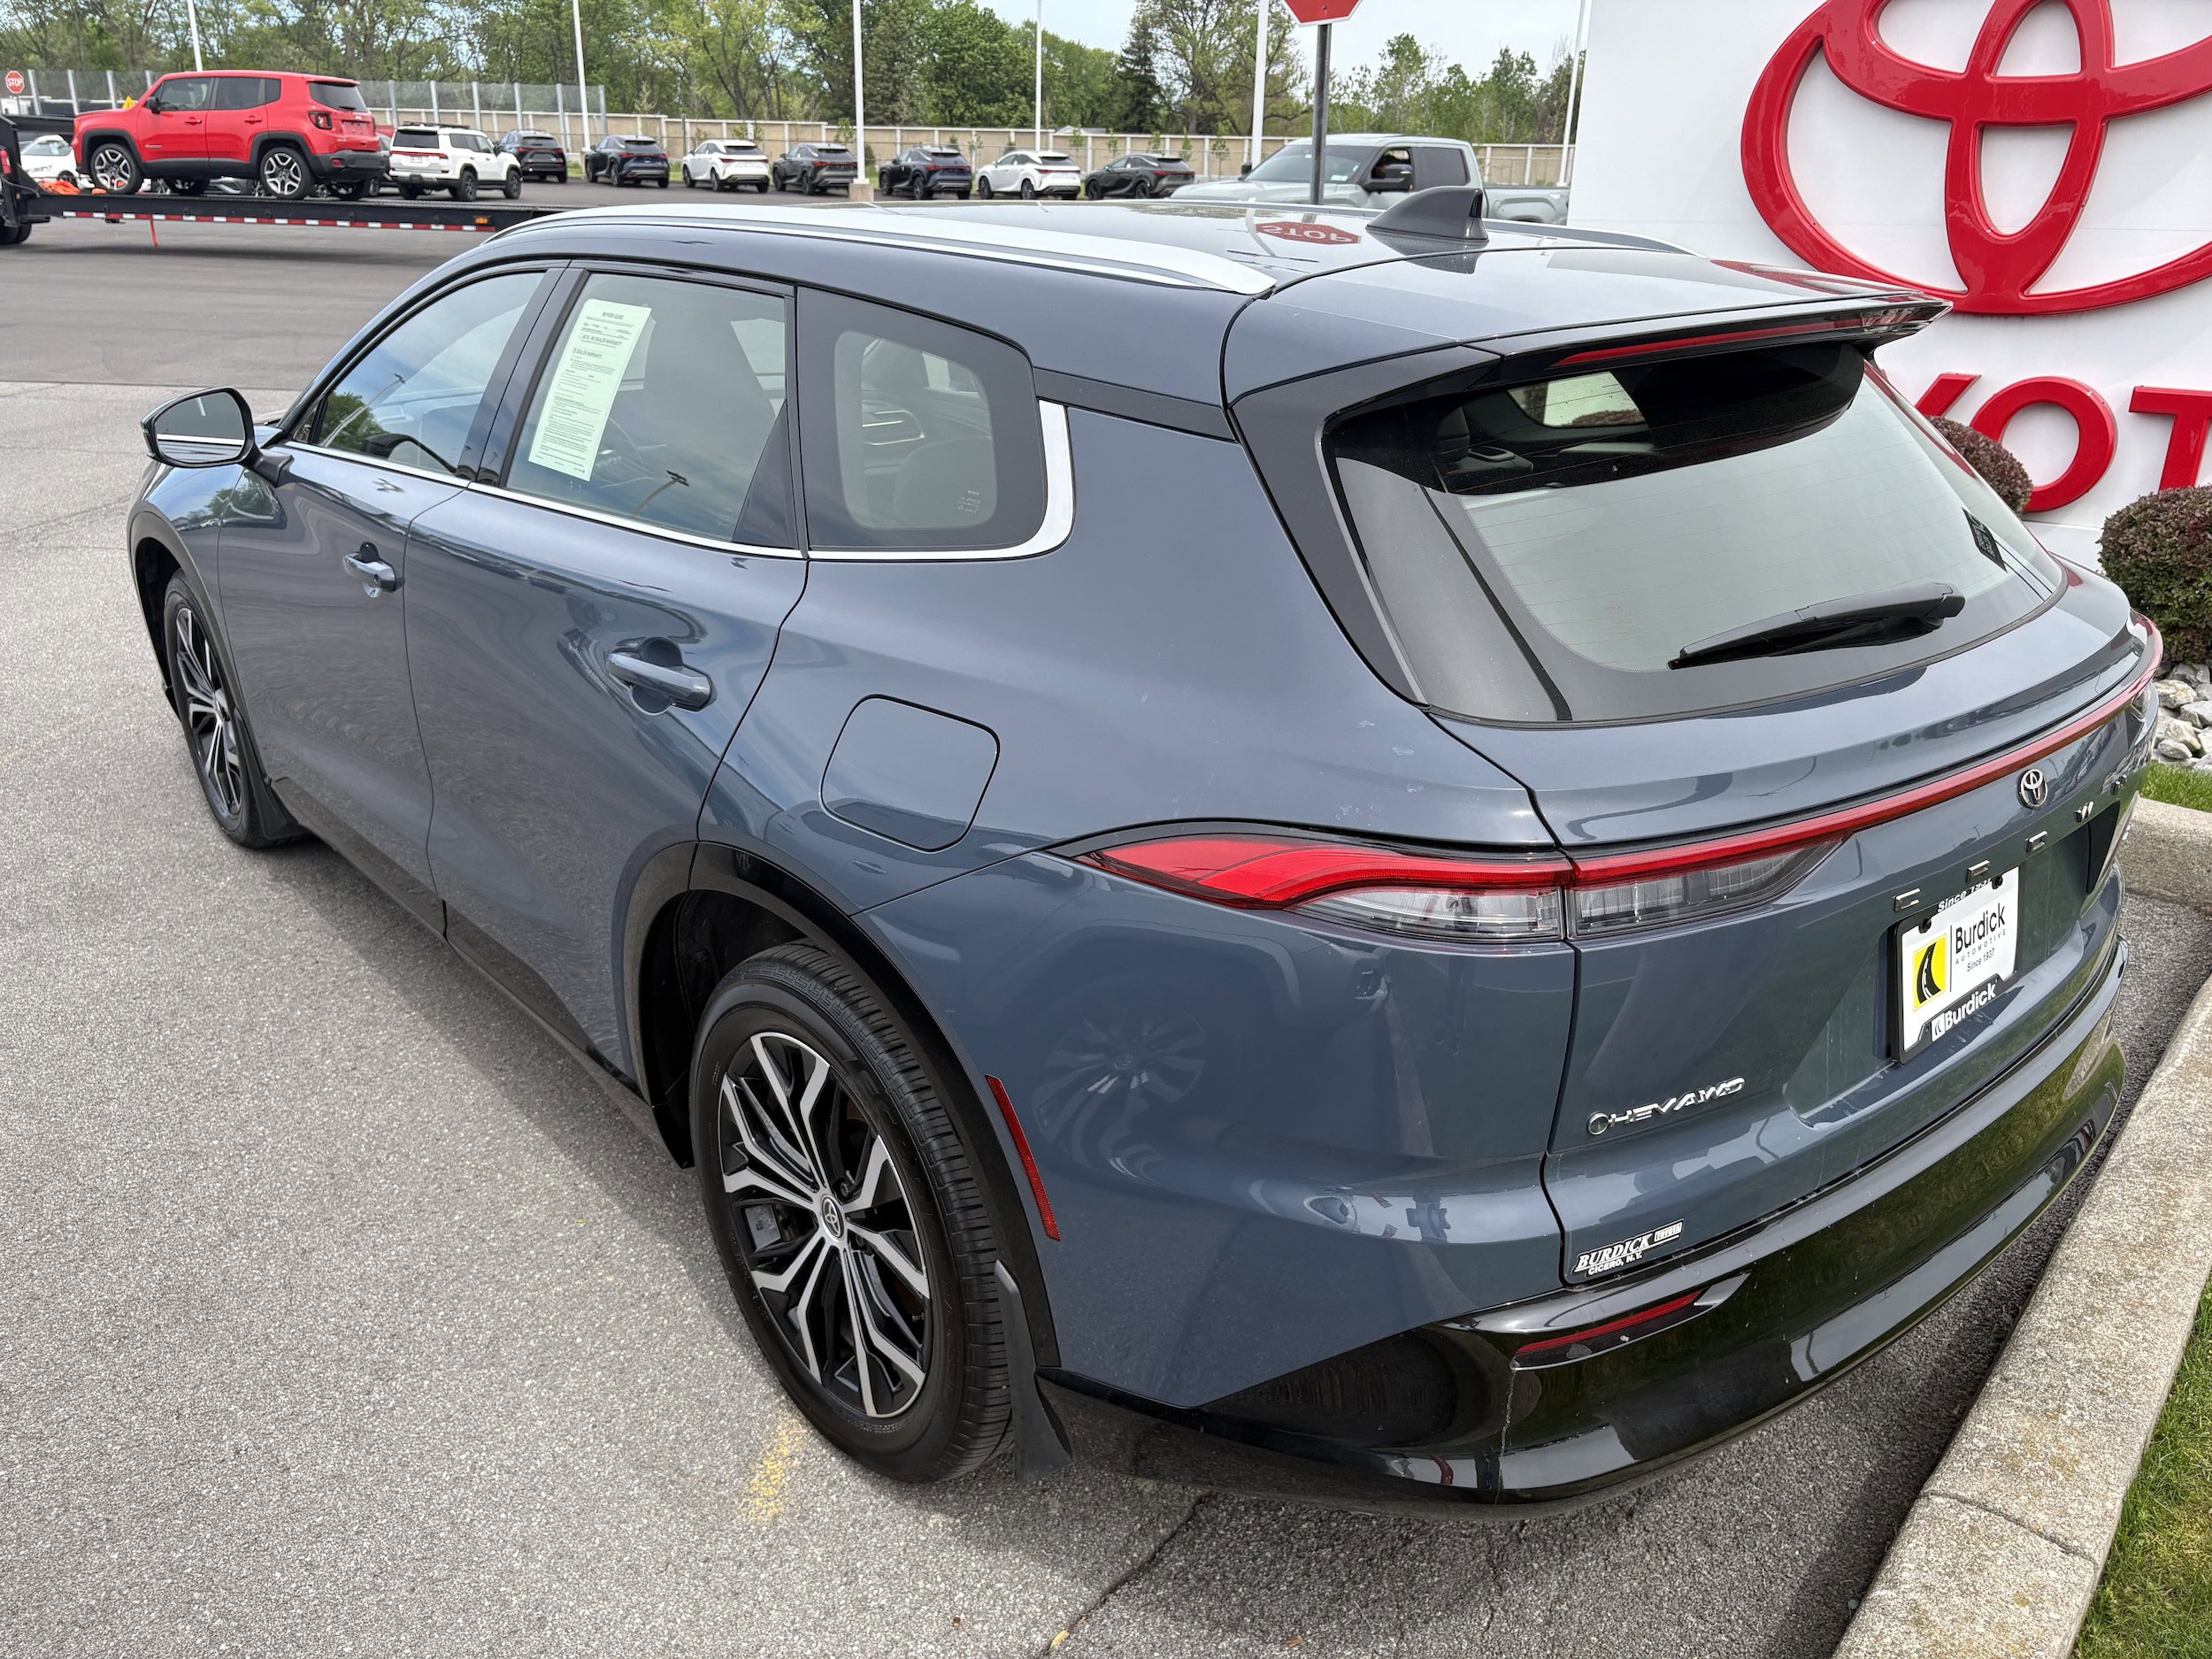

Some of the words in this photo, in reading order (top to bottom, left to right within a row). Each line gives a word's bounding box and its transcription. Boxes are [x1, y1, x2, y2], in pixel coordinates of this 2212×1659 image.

[7, 78, 23, 87] STOP
[1915, 373, 2212, 513] OT
[1937, 890, 1967, 913] Since
[1955, 902, 2006, 955] Burdick
[1955, 929, 2007, 964] AUTOMOTIVE
[1967, 957, 1982, 972] Since
[1983, 947, 1995, 963] 1937
[1945, 981, 1996, 1032] Burdick
[1576, 1233, 1653, 1269] BURDICK
[1656, 1223, 1682, 1241] TOYOTA
[1588, 1258, 1624, 1276] CICERO,
[1626, 1251, 1643, 1263] N.Y.
